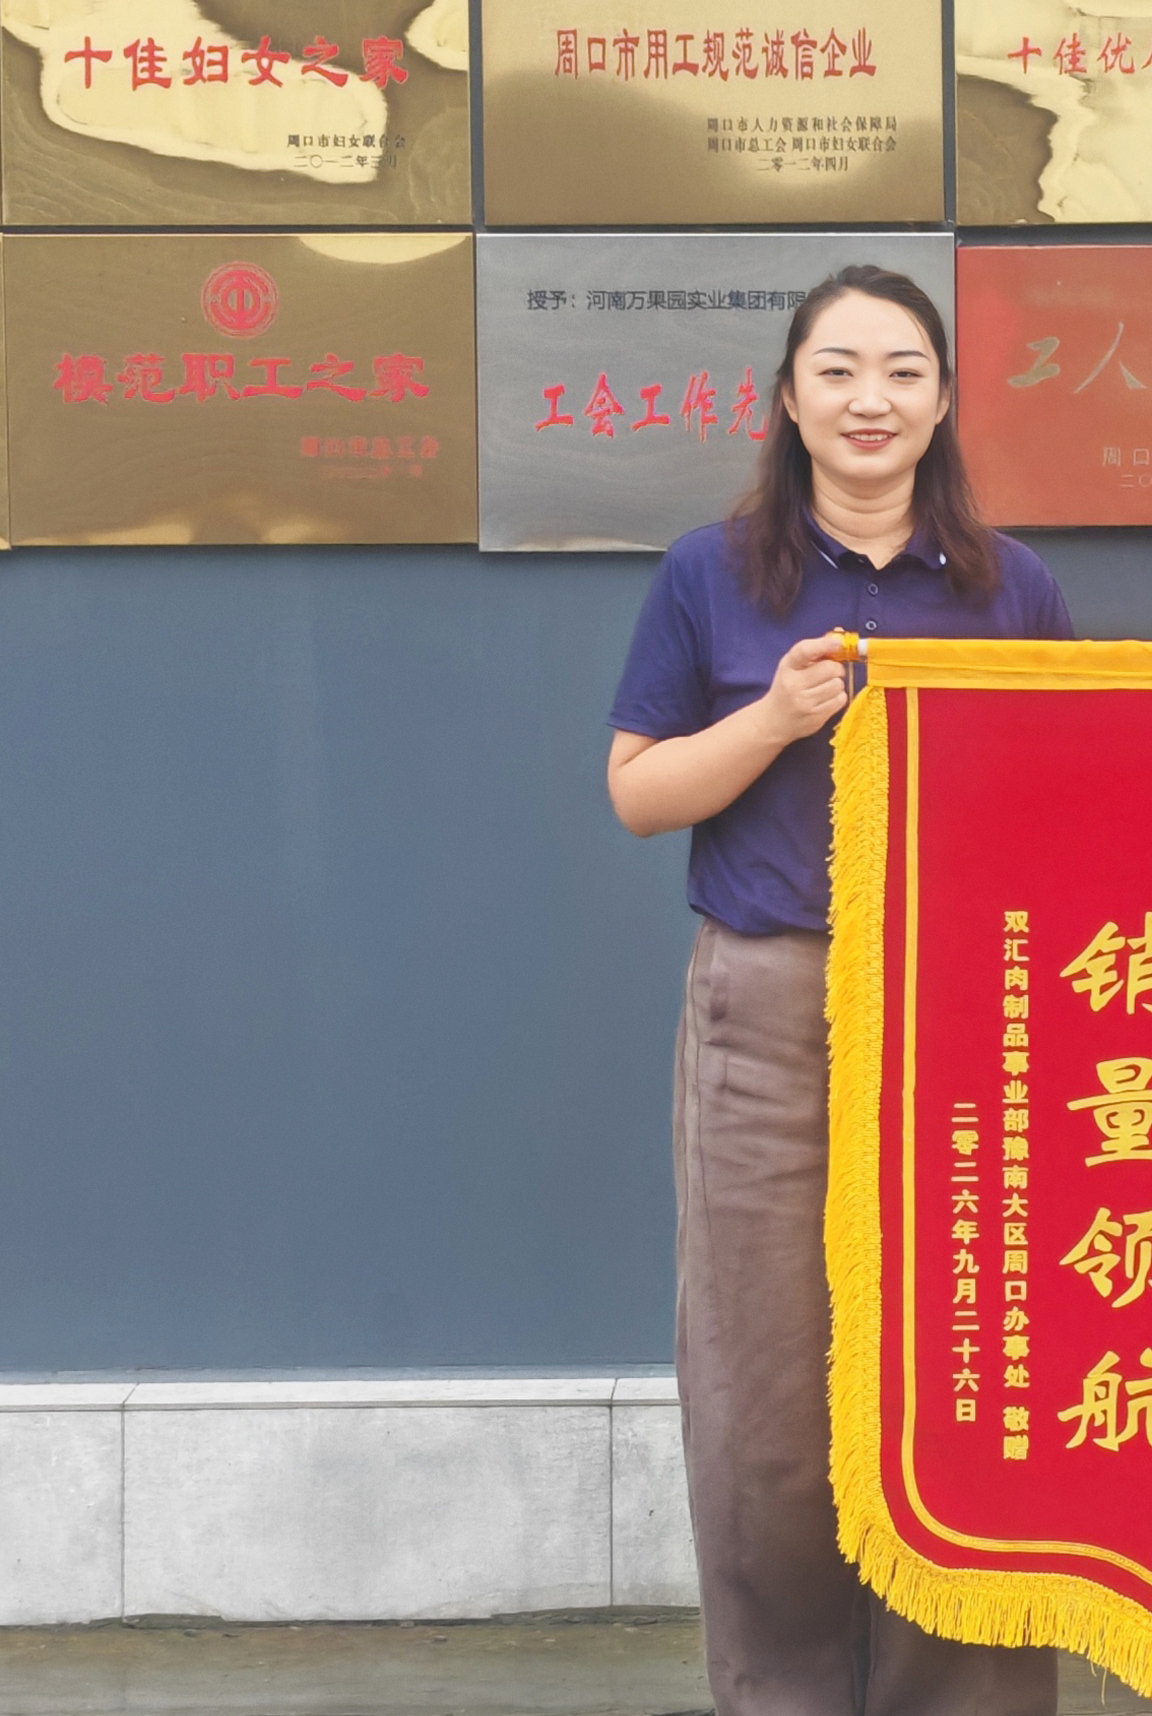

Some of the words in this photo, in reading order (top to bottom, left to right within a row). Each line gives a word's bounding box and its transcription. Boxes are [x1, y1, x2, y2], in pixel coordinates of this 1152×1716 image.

[64, 35, 409, 91] 十佳妇女之家
[554, 27, 877, 81] 周口市用工规范诚信企业
[287, 133, 406, 148] 周口市妇女联合会
[707, 116, 897, 132] 周口市人力资源和社会保障局
[707, 136, 787, 153] 周口市总工会
[791, 136, 897, 153] 周口市妇女联合会
[756, 156, 849, 171] 二零一二年四月
[52, 352, 430, 405] 模范职工之家
[535, 366, 769, 443] 工会工作先
[1002, 910, 1030, 1388] 双汇肉制品事业部豫南大区周口办事处
[951, 1102, 981, 1422] 二零二六年九月二十六日
[1002, 1405, 1030, 1460] 敬赠
